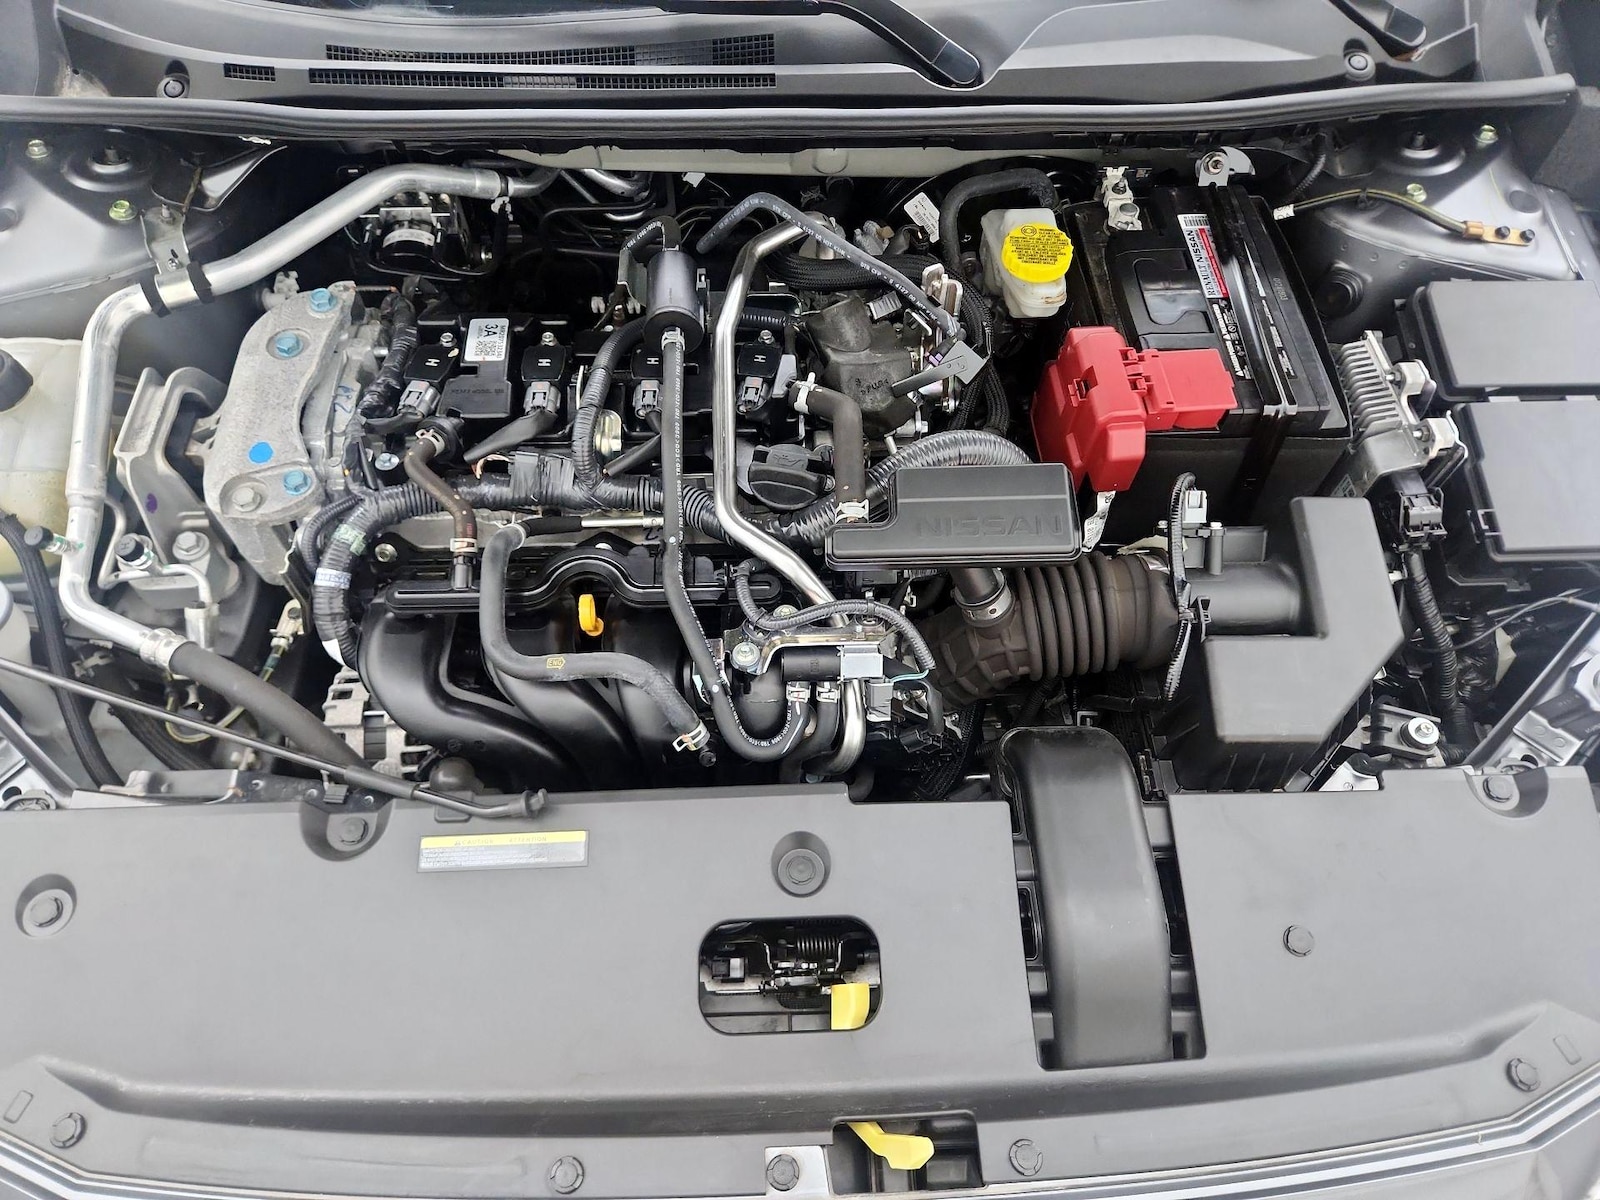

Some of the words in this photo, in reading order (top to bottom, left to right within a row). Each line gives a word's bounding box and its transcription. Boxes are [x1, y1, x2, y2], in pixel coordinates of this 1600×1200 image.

[1186, 229, 1204, 263] NISSAN
[1198, 264, 1216, 296] RENAULT
[483, 323, 499, 338] 3A
[917, 514, 1063, 538] NISSAN
[509, 836, 547, 844] ATTENTION
